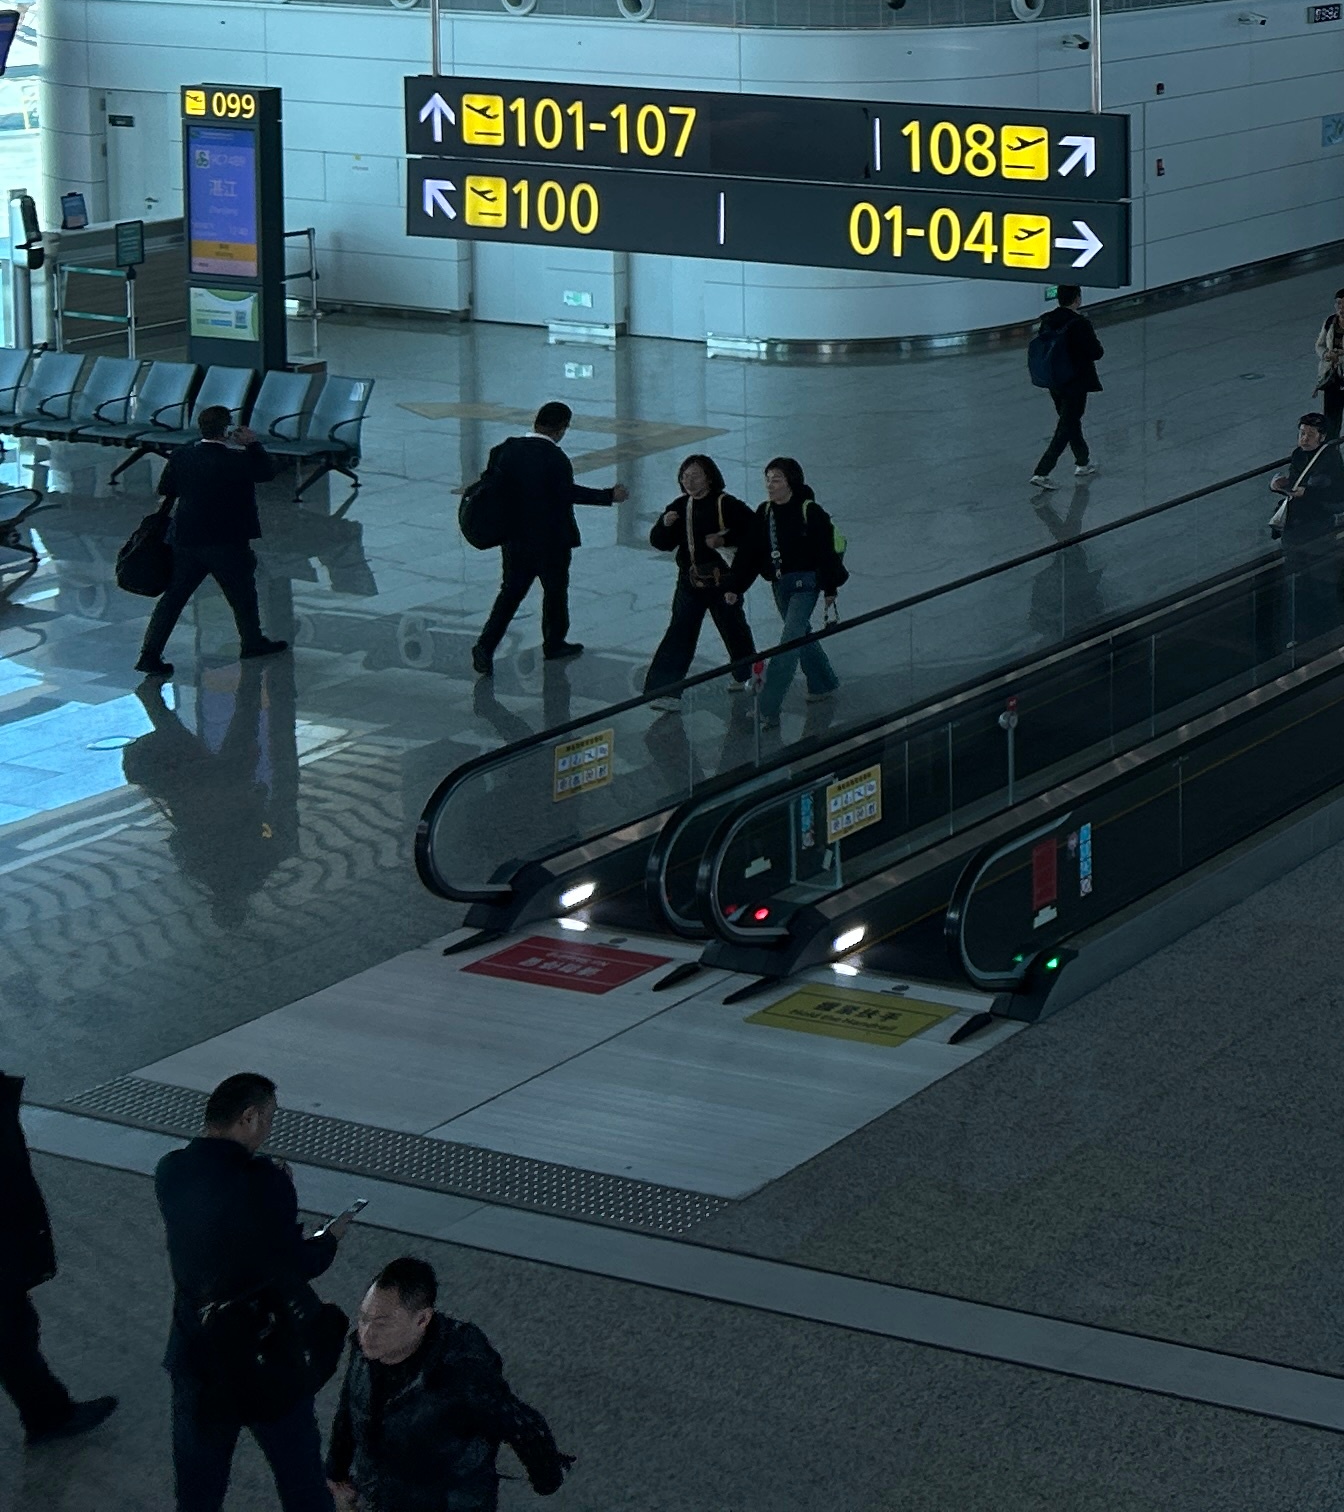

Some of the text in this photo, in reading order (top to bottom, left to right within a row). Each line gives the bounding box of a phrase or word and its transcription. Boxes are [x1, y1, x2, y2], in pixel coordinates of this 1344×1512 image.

[212, 92, 256, 119] 099
[509, 97, 696, 159] 101-107
[902, 118, 997, 177] 108
[512, 180, 599, 235] 100
[849, 201, 999, 265] 01-04
